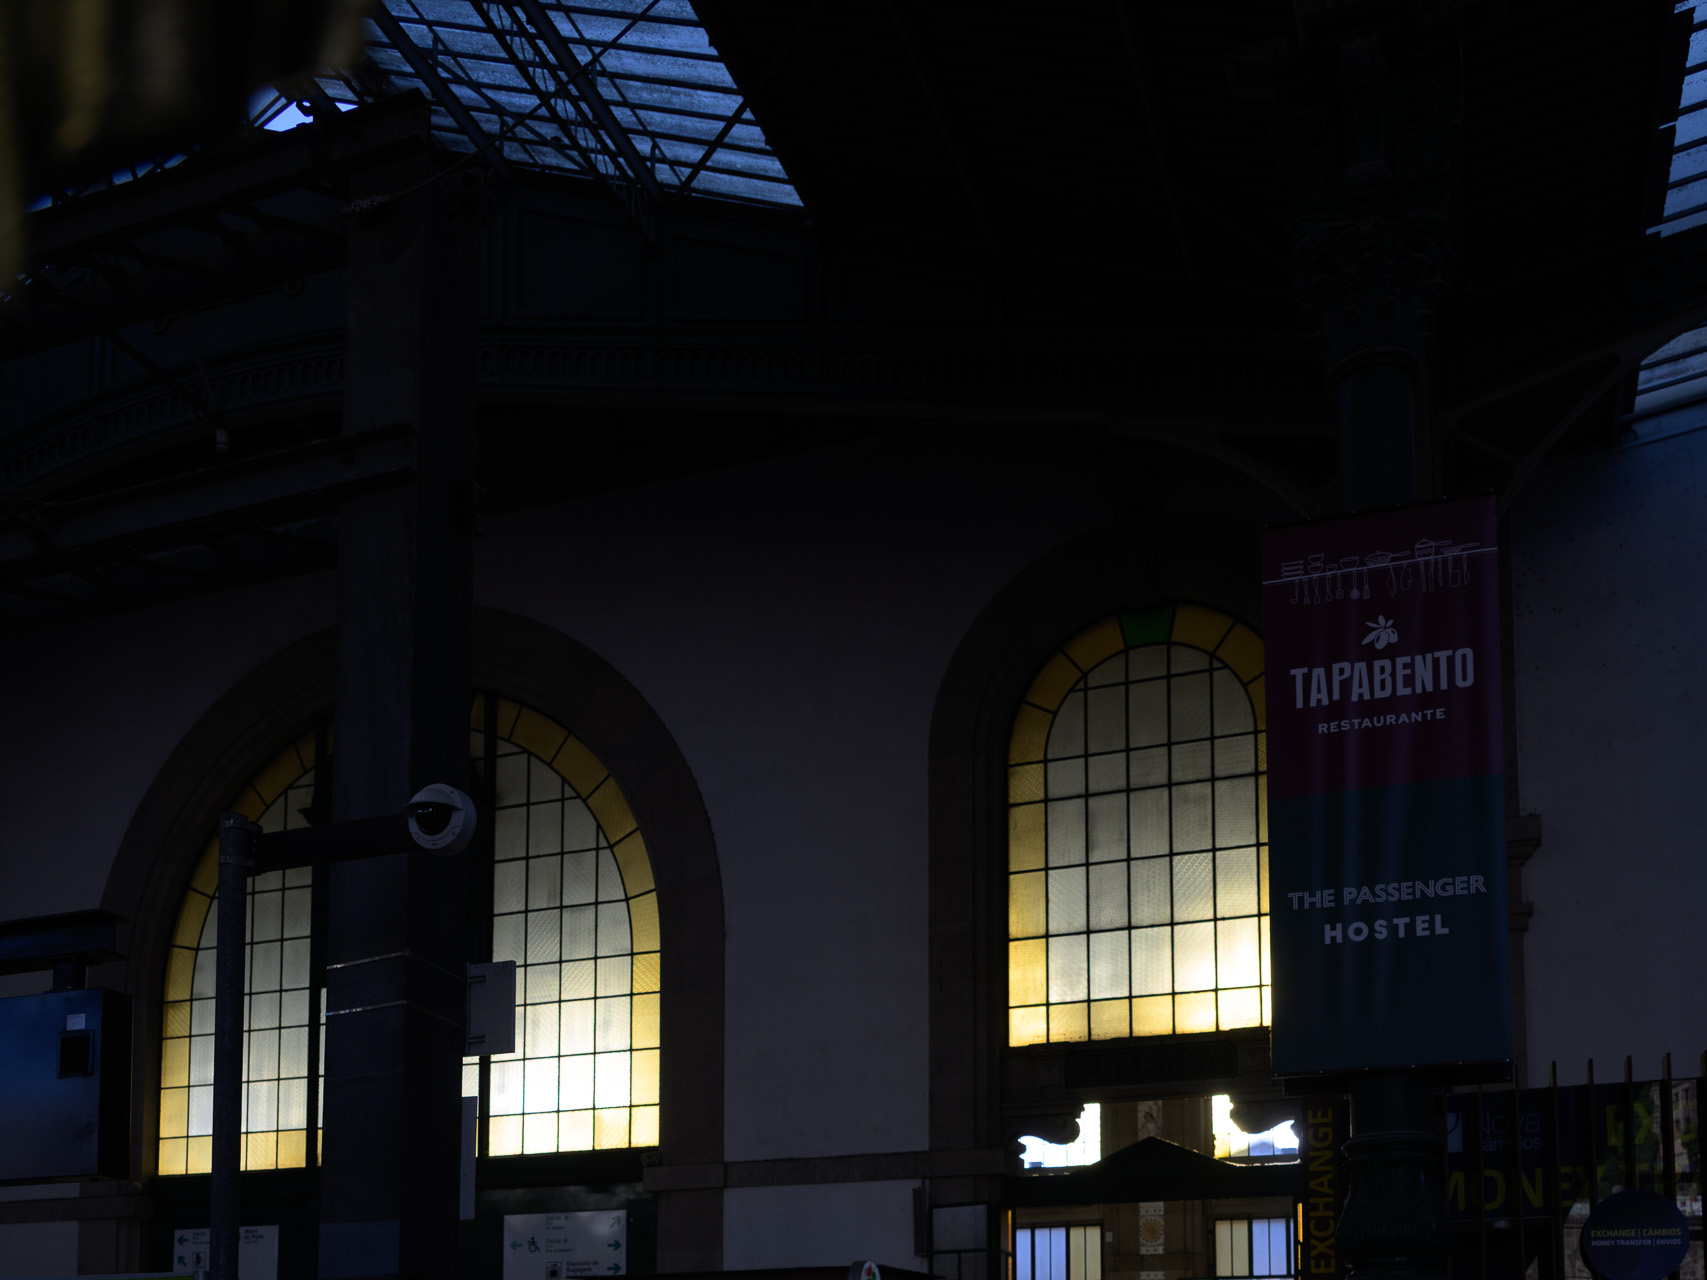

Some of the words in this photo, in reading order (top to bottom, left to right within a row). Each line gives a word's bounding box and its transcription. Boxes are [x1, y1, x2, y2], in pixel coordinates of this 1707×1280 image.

[1290, 647, 1475, 709] TAPABENTO
[1318, 708, 1447, 734] RESTAURANTE
[1288, 887, 1336, 911] THE
[1343, 874, 1488, 907] PASSENGER
[1324, 913, 1450, 945] HOSTEL
[1079, 1049, 1220, 1081] ENTRADA
[1307, 1107, 1336, 1275] EXCHANGE
[1590, 1228, 1637, 1238] EXCHANGE
[1643, 1226, 1682, 1237] CÂMBIOS
